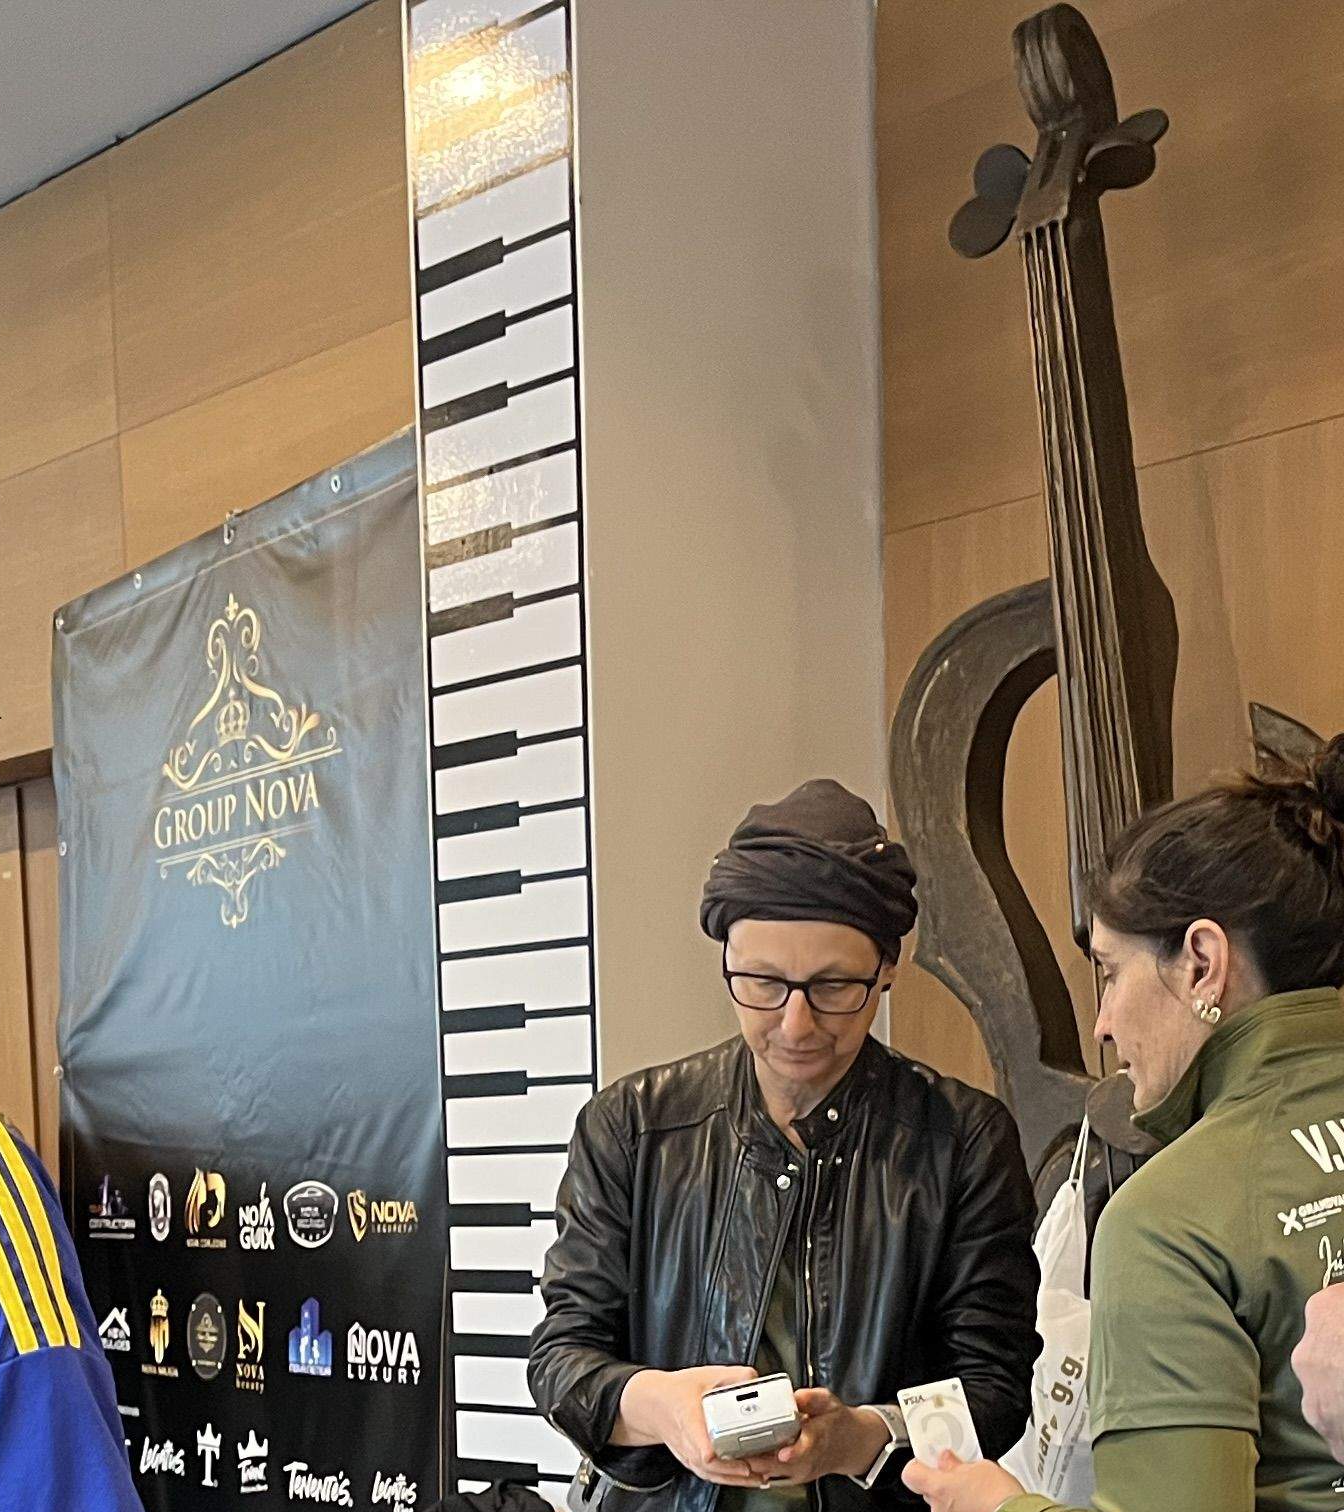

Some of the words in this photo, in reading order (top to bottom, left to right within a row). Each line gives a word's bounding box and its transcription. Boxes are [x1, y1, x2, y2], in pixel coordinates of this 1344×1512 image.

[154, 793, 236, 850] GROUP
[245, 770, 320, 826] NOVA
[371, 1200, 419, 1223] NOVA
[239, 1226, 275, 1250] GUIX
[347, 1363, 421, 1386] LUXURY
